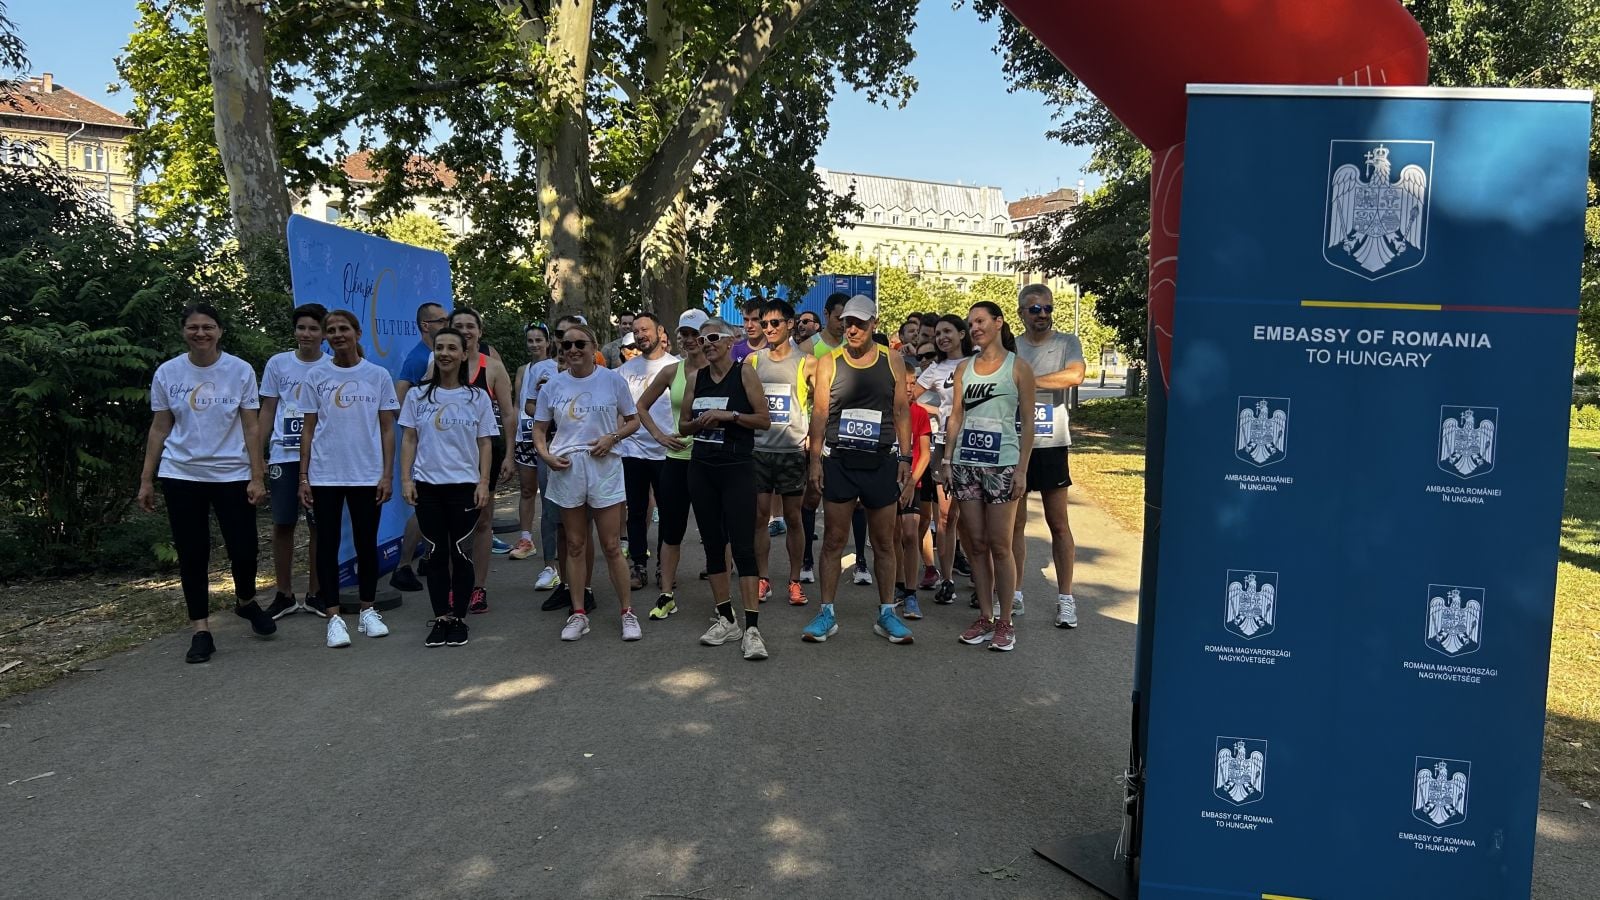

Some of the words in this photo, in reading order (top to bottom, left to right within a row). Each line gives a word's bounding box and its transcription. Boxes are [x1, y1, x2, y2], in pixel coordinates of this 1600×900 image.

[1253, 325, 1350, 343] EMBASSY
[1357, 329, 1385, 344] OF
[1392, 330, 1492, 348] ROMANIA
[1306, 349, 1331, 364] TO
[1336, 350, 1432, 367] HUNGARY
[964, 383, 998, 399] NIKE
[847, 421, 873, 437] 038
[968, 432, 993, 448] 039
[1224, 474, 1260, 482] AMBASADA
[1425, 485, 1465, 494] AMBASADA
[1451, 495, 1484, 504] UNGARIA
[1235, 647, 1291, 658] MAGYARORSZÁGI
[1219, 654, 1276, 664] NAGYKÖVETSÉGE
[1437, 664, 1498, 676] MAGYARORSZÁGI
[1418, 671, 1480, 683] NAGYKÖVETSÉGE
[1201, 810, 1231, 819] EMBASSY
[1243, 814, 1273, 824] ROMANIA
[1225, 821, 1258, 830] HUNGARY
[1398, 832, 1432, 841] EMBASSY
[1443, 837, 1476, 847] ROMANIA
[1425, 844, 1459, 853] HUNGARY
